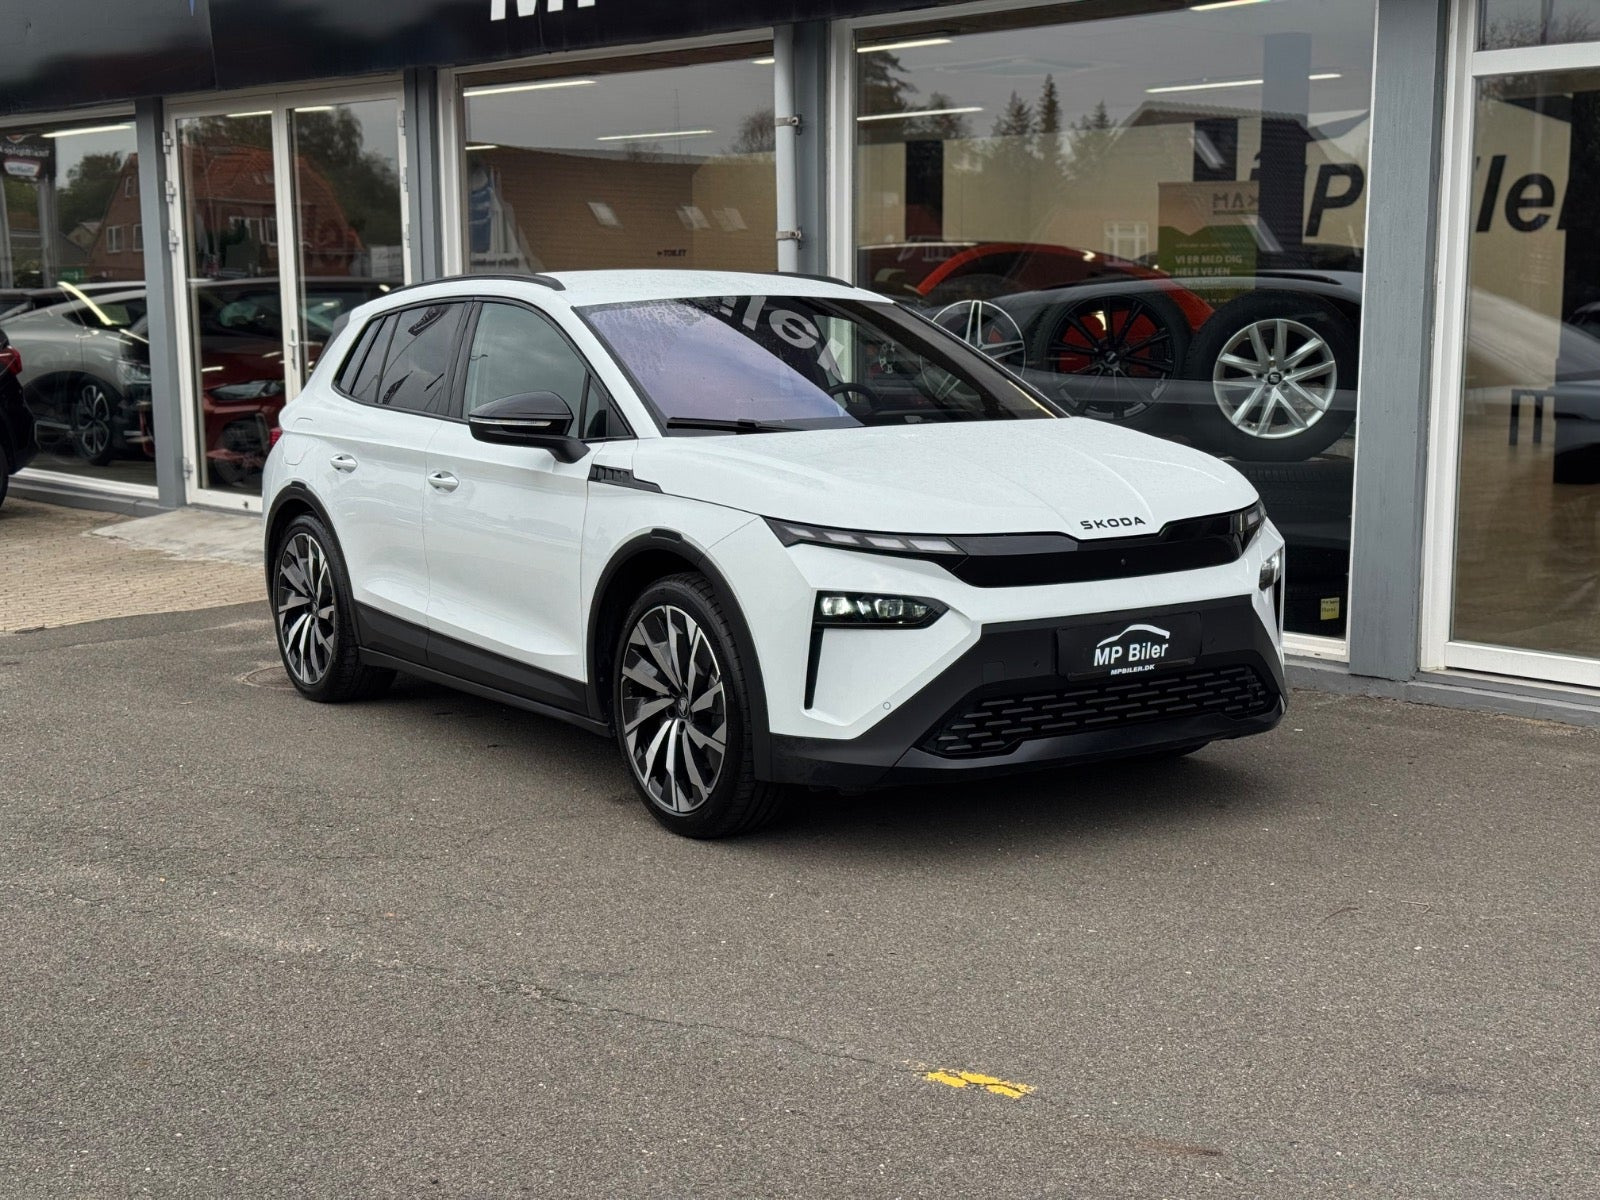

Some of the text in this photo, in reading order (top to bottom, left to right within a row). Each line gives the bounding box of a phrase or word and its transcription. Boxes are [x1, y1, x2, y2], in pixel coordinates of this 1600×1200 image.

[1175, 254, 1243, 265] VI ER MED DIG
[1175, 266, 1231, 276] HELE VEJEN
[1093, 643, 1169, 667] MP Biler
[1110, 664, 1155, 676] MPBILER.DK
